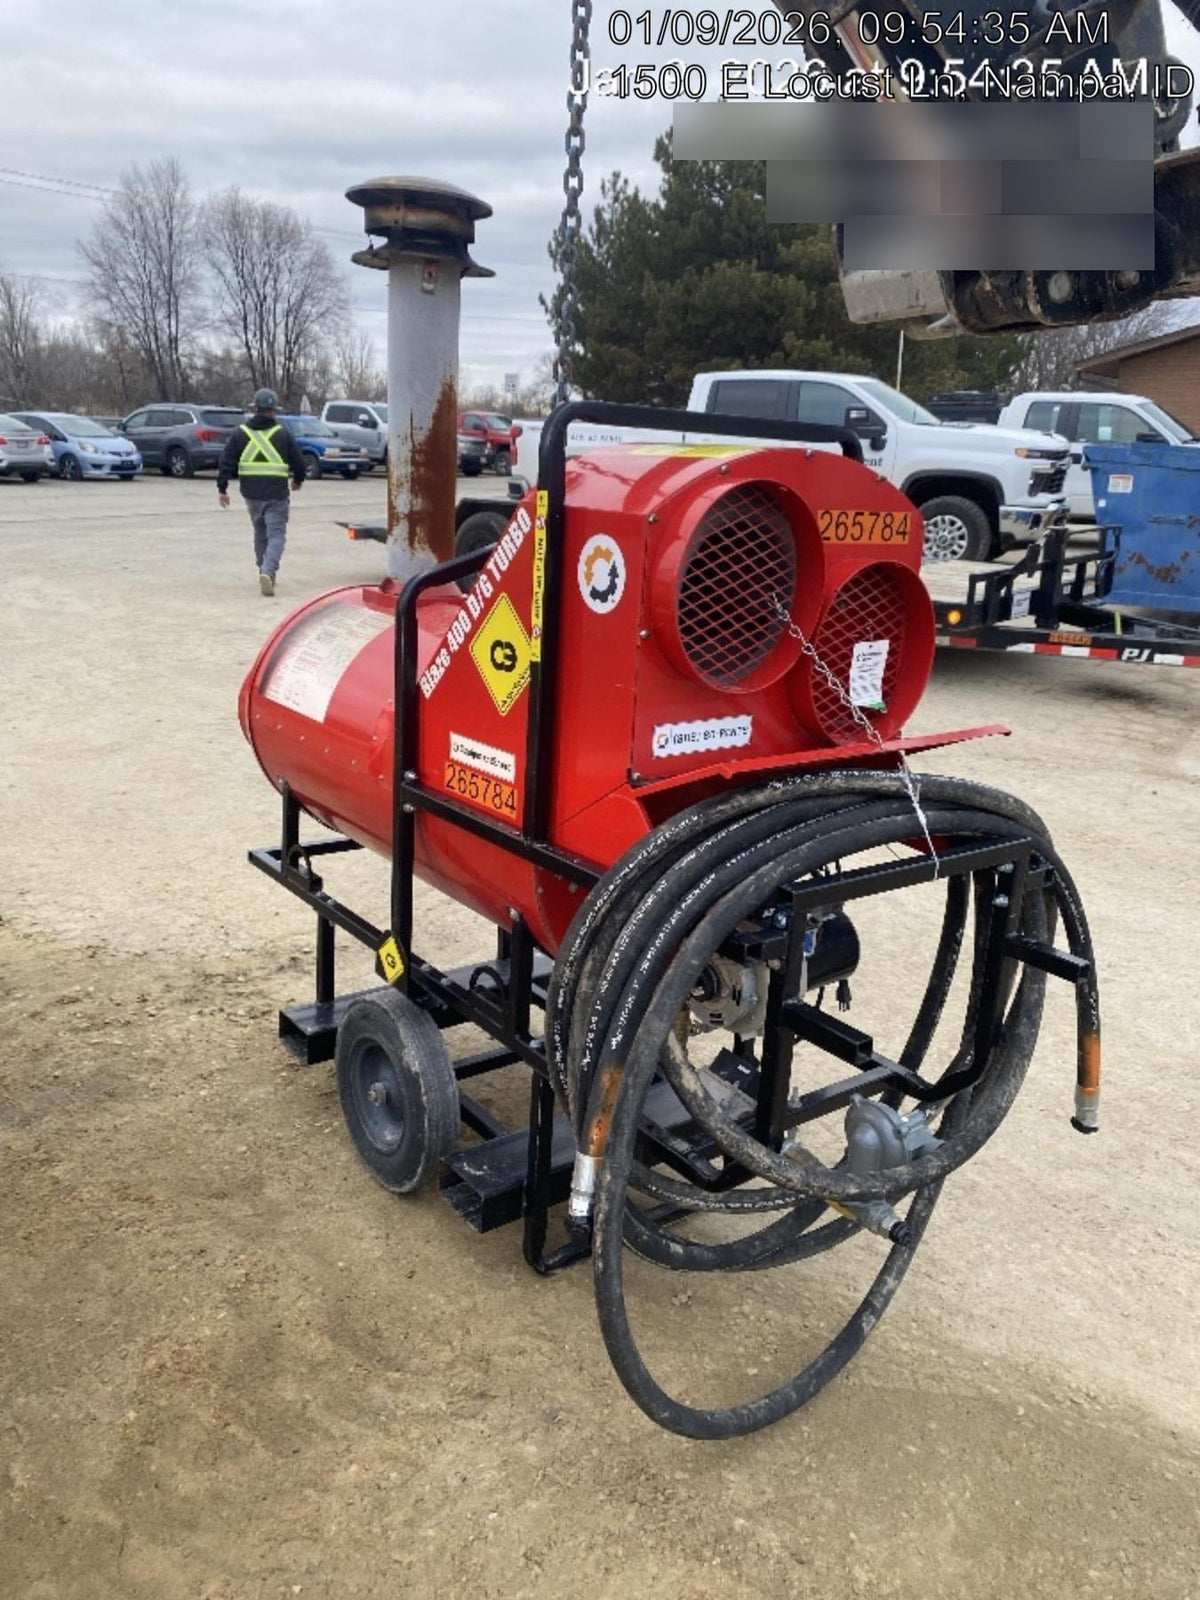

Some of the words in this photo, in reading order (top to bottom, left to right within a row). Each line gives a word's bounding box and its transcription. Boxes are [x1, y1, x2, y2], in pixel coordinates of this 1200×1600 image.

[820, 510, 910, 544] 265784
[419, 648, 450, 699] Blaze
[447, 609, 472, 653] 400
[465, 573, 494, 620] D/G
[486, 507, 532, 582] TURBO
[1121, 647, 1152, 662] PJ
[444, 764, 517, 813] 265784
